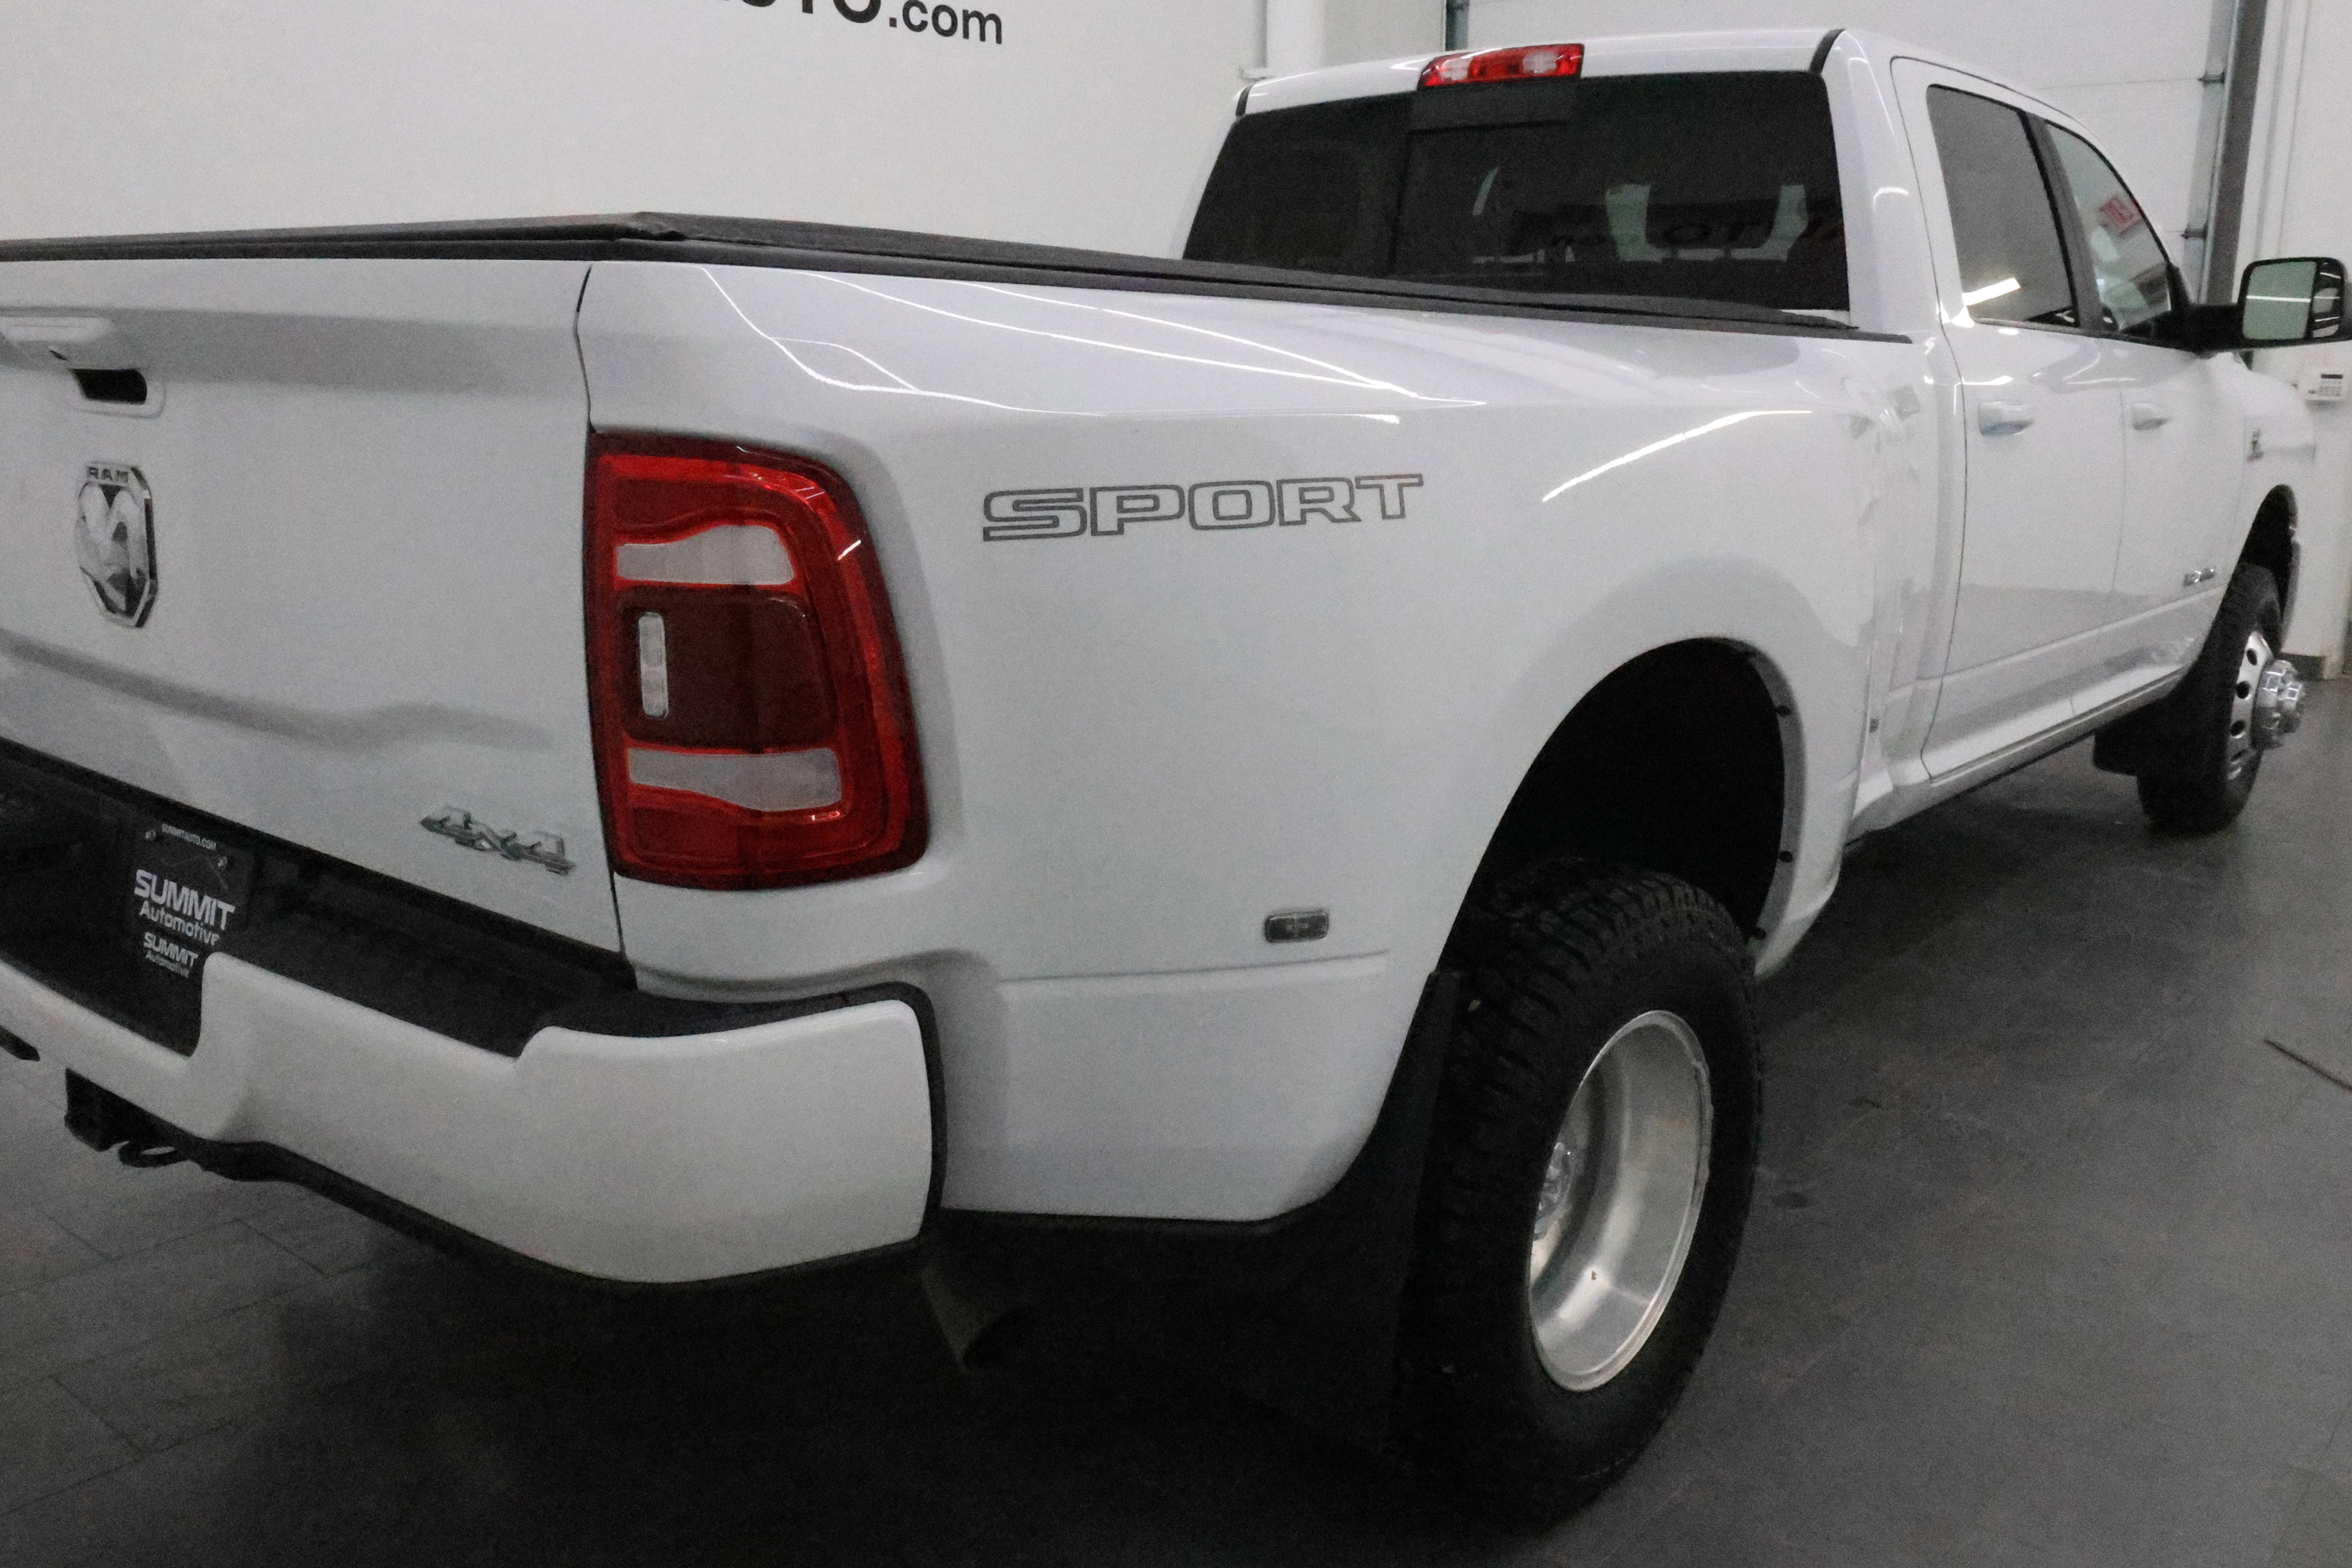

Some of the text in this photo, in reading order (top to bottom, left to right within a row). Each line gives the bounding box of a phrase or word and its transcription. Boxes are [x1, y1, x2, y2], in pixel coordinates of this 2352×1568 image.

[87, 466, 129, 483] RAM
[982, 474, 1423, 541] SPORT
[134, 869, 236, 930] SUMMIT
[139, 900, 220, 946] Automotive
[143, 931, 199, 967] SUMMIT
